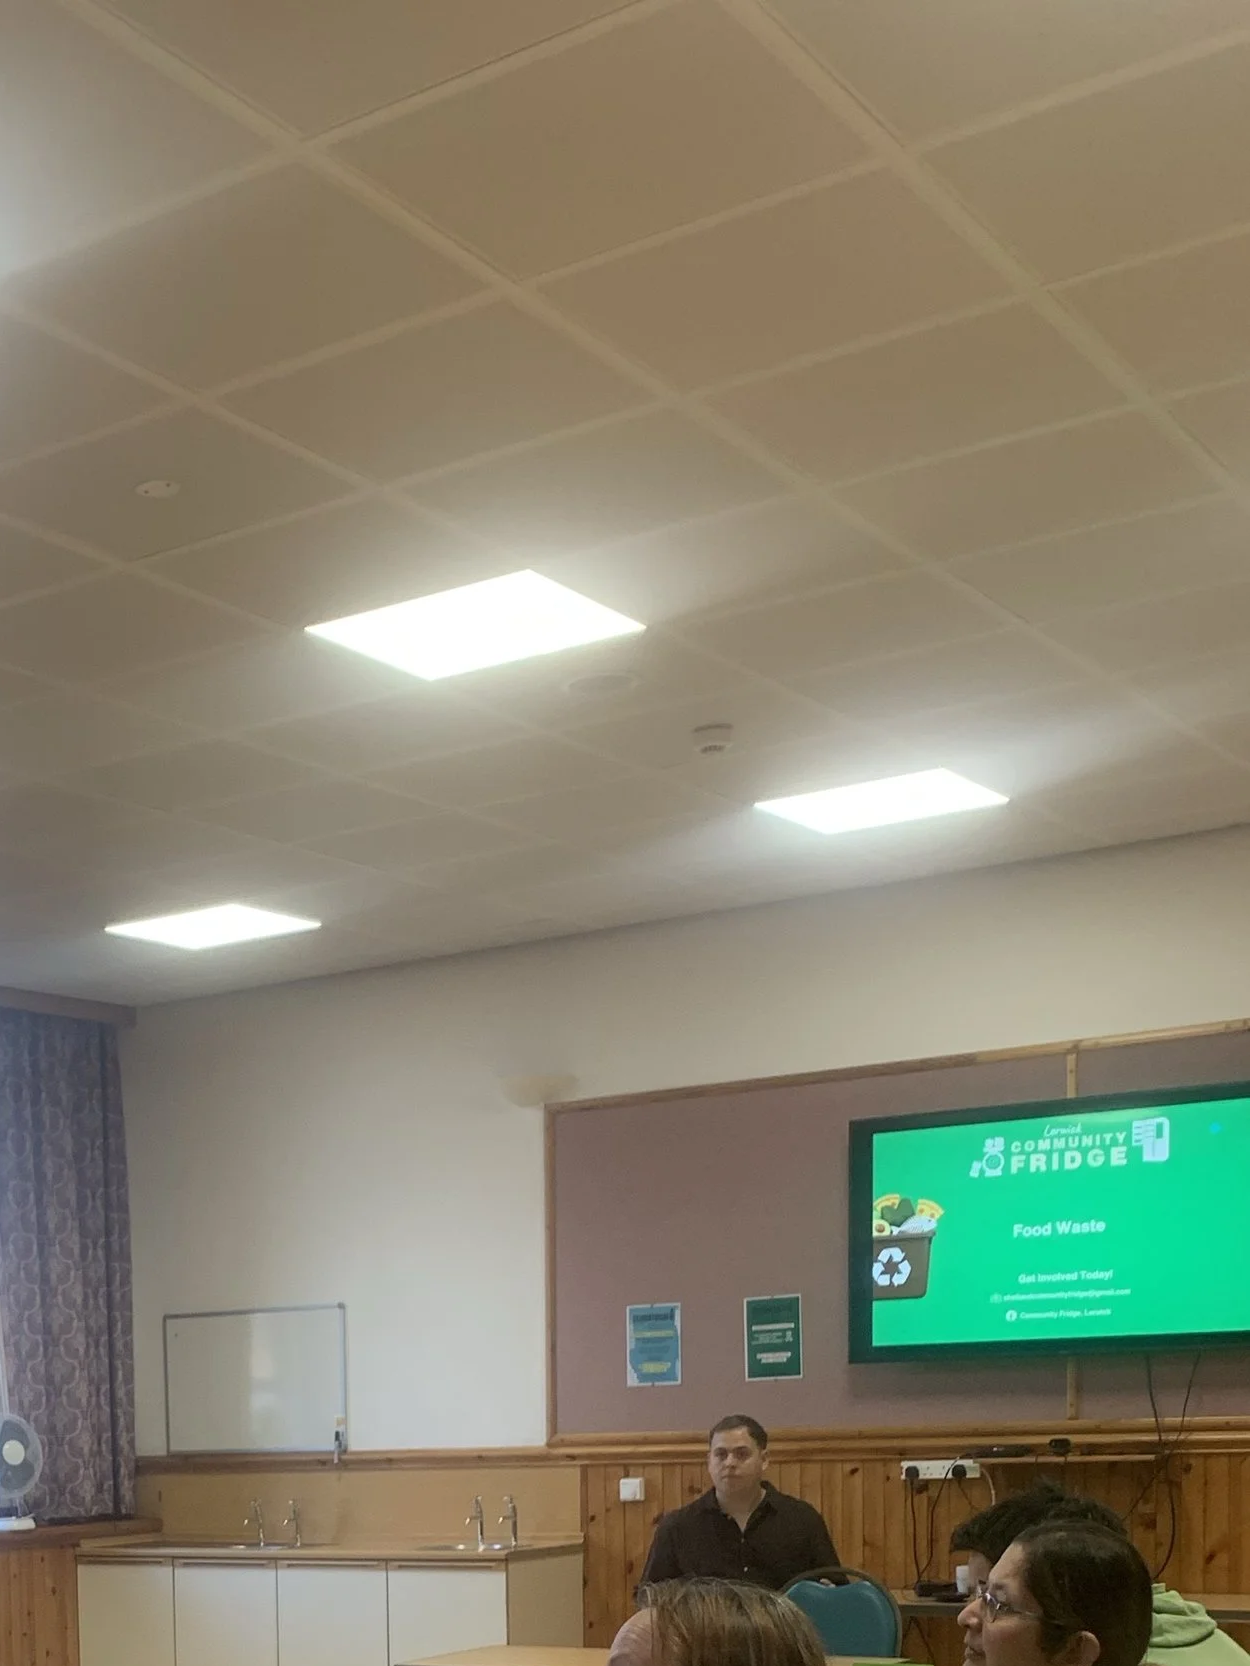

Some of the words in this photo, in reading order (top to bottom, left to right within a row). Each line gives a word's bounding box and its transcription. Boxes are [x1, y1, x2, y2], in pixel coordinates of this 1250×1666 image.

[1043, 1122, 1083, 1137] Lerwick
[1010, 1131, 1128, 1153] COMMUNITY
[1010, 1146, 1128, 1174] FRIDGE
[1012, 1222, 1052, 1238] Food
[1056, 1219, 1106, 1235] Waste
[1017, 1273, 1036, 1285] Get
[1037, 1271, 1078, 1283] Involved
[1079, 1269, 1114, 1281] Today!
